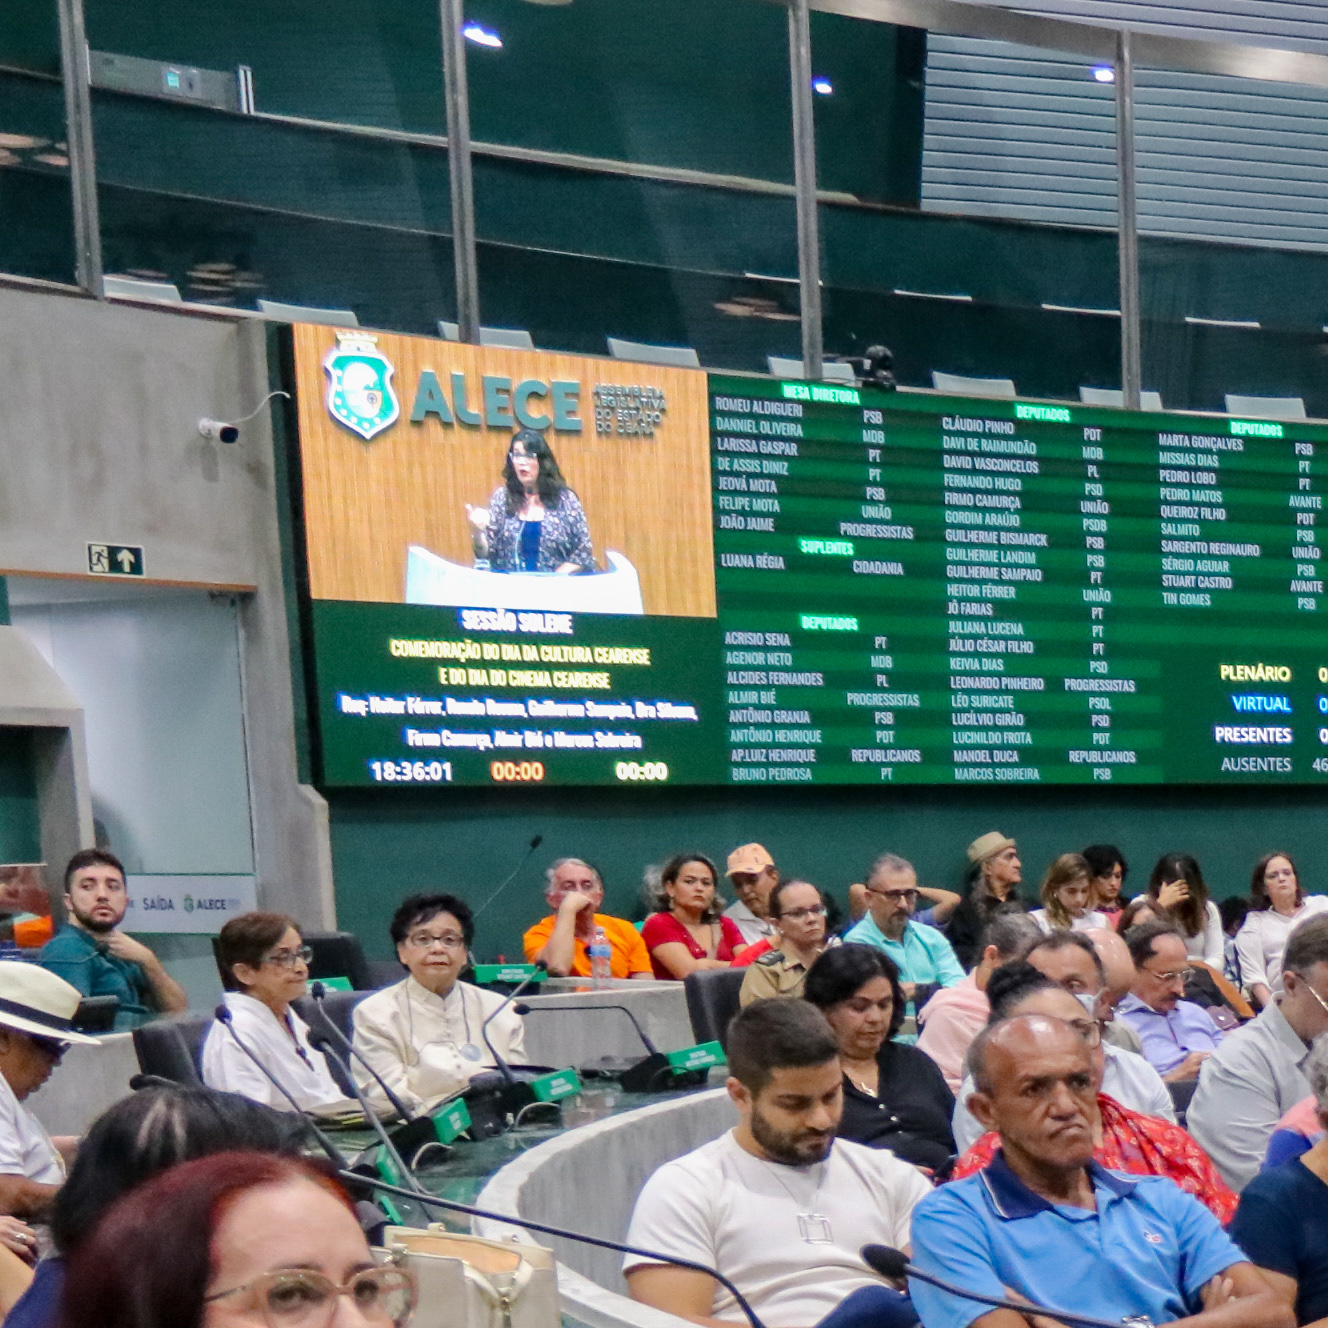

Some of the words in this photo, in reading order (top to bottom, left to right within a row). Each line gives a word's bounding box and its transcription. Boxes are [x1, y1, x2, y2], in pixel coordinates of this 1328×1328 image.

[411, 370, 582, 430] ALECE
[812, 386, 860, 404] DIRETORA
[716, 397, 750, 412] ROMEU
[752, 400, 803, 417] ALDIGUERI
[1018, 405, 1070, 421] DEPUTADOS
[716, 417, 758, 433] DANNIEL
[760, 420, 803, 436] OLIVEIRA
[942, 415, 984, 432] CLÁUDIO
[985, 420, 1015, 434] PINHO
[1232, 421, 1283, 437] DEPUTADOS
[717, 437, 758, 452] LARISSA
[760, 440, 798, 456] GASPAR
[943, 436, 965, 449] DAVI
[967, 438, 979, 451] DE
[981, 438, 1036, 455] RAIMUNDÃO
[1159, 433, 1190, 447] MARTA
[1192, 436, 1244, 452] GONÇALVES
[718, 457, 730, 470] DE
[733, 458, 761, 472] ASSIS
[762, 460, 788, 475] DINIZ
[944, 455, 972, 468] DAVID
[974, 457, 1039, 473] VASCONCELOS
[1160, 452, 1196, 466] MISSIAS
[1198, 454, 1219, 467] DIAS
[718, 475, 748, 491] JEOVÁ
[750, 479, 777, 493] MOTA
[944, 474, 993, 488] FERNANDO
[995, 478, 1022, 490] HUGO
[1160, 470, 1190, 483] PEDRO
[1192, 472, 1216, 484] LOBO
[945, 492, 974, 506] FIRMO
[976, 494, 1021, 512] CAMURÇA
[1160, 488, 1190, 500] PEDRO
[1192, 490, 1222, 502] MATOS
[1289, 496, 1321, 508] AVANTE
[720, 496, 748, 510] FELIPE
[752, 498, 780, 512] MOTA
[862, 504, 892, 520] UNIÃO
[945, 510, 982, 524] GORDIM
[985, 510, 1020, 527] ARAÚJO
[1161, 505, 1199, 519] QUEIROZ
[1201, 507, 1226, 520] FILHO
[1297, 513, 1314, 524] PDT
[720, 514, 745, 529] JOÃO
[747, 517, 774, 532] JAIME
[840, 522, 914, 539] PROGRESSISTAS
[1161, 523, 1200, 536] SALMITO
[946, 529, 998, 544] GUILHERME
[1000, 532, 1048, 546] BISMARCK
[946, 548, 998, 562] GUILHERME
[1001, 551, 1036, 564] LANDIM
[1162, 540, 1208, 554] SARGENTO
[1210, 542, 1260, 556] REGINAURO
[1292, 545, 1321, 559] UNIÃO
[722, 554, 754, 568] LUANA
[756, 553, 785, 569] RÉGIA
[853, 560, 904, 575] CIDADANIA
[1162, 556, 1194, 571] SÉRGIO
[1196, 560, 1230, 572] AGUIAR
[947, 565, 999, 580] GUILHERME
[1001, 568, 1042, 581] SAMPAIO
[1162, 575, 1196, 587] STUART
[1198, 576, 1232, 589] CASTRO
[1290, 580, 1322, 592] AVANTE
[948, 584, 980, 596] HEITOR
[982, 583, 1016, 598] FÉRRER
[1162, 592, 1178, 604] TIN
[1180, 593, 1211, 606] GOMES
[948, 599, 959, 614] JÔ
[961, 602, 993, 616] FARIAS
[802, 616, 858, 630] DEPUTADOS
[949, 621, 986, 634] JULIANA
[988, 622, 1024, 634] LUCENA
[765, 633, 791, 646] SENA
[949, 636, 975, 652] JÚLIO
[976, 637, 1006, 652] CÉSAR
[1008, 640, 1034, 653] FILHO
[391, 639, 480, 662] COMEMORAÇÃO
[484, 643, 499, 659] DO
[502, 644, 521, 660] DIA
[523, 645, 538, 661] DA
[540, 645, 593, 663] CULTURA
[594, 648, 651, 665] CEARENSE
[726, 652, 765, 664] AGENOR
[767, 652, 792, 666] NETO
[950, 658, 980, 670] KEIVIA
[982, 658, 1004, 670] DIAS
[439, 668, 448, 684] E
[450, 668, 466, 685] DO
[468, 669, 488, 686] DIA
[491, 670, 506, 686] DO
[508, 670, 551, 687] CINEMA
[553, 671, 611, 689] CEARENSE
[727, 671, 767, 684] ALCIDES
[769, 672, 824, 685] FERNANDES
[1221, 663, 1291, 682] PLENÁRIO
[1318, 668, 1328, 682] 0
[950, 676, 1000, 689] LEONARDO
[1001, 677, 1044, 690] PINHEIRO
[1064, 678, 1136, 692] PROGRESSISTAS
[728, 691, 758, 704] ALMIR
[760, 688, 776, 704] BIÉ
[847, 693, 920, 706] PROGRESSISTAS
[952, 692, 969, 707] LÉO
[971, 696, 1014, 708] SURICATE
[1232, 696, 1290, 710] VIRTUAL
[1320, 698, 1328, 711] 0
[729, 707, 772, 723] ANTÔNIO
[774, 710, 810, 723] GRANJA
[952, 710, 994, 726] LUCÍLVIO
[995, 712, 1024, 726] GIRÃO
[730, 726, 773, 742] ANTÔNIO
[775, 730, 822, 744] HENRIQUE
[953, 732, 1002, 744] LUCINILDO
[1004, 732, 1032, 744] FROTA
[1216, 727, 1292, 742] PRESENTES
[768, 749, 816, 763] HENRIQUE
[852, 749, 921, 762] REPUBLICANOS
[954, 750, 992, 762] MANOEL
[993, 750, 1019, 762] DUCA
[1069, 750, 1136, 763] REPUBLICANOS
[372, 762, 452, 780] 18:36:01
[493, 762, 544, 780] 00:00
[616, 762, 668, 780] 00:00
[1221, 758, 1292, 771] AUSENTES
[732, 768, 766, 780] BRUNO
[768, 768, 812, 780] PEDROSA
[955, 768, 994, 780] MARCOS
[995, 768, 1040, 780] SOBREIRA
[143, 894, 174, 910] SAÍDA
[196, 898, 226, 910] ALECE
